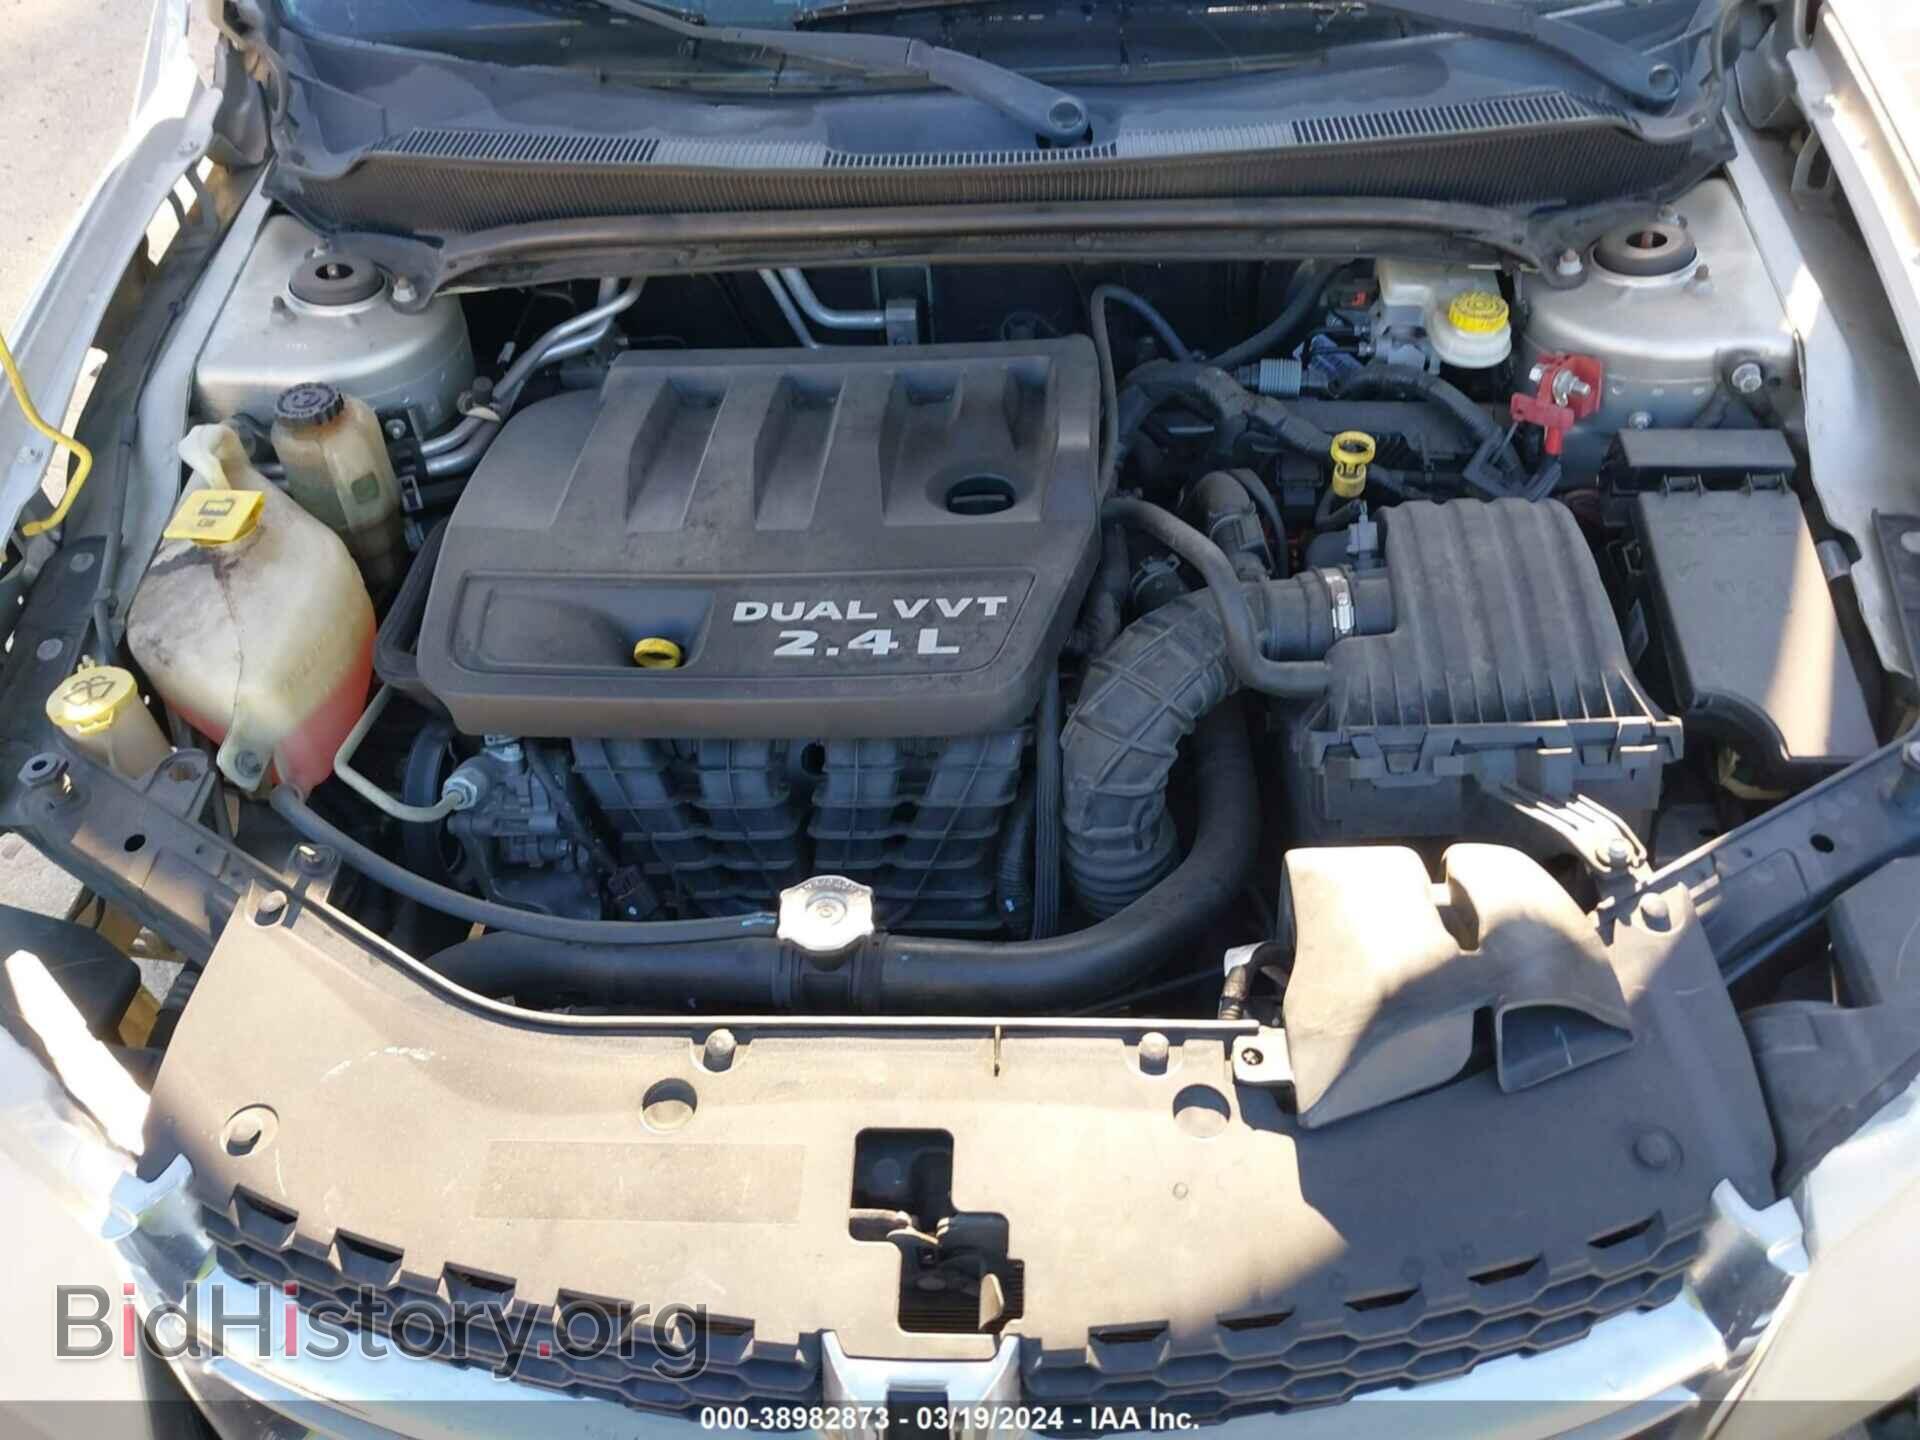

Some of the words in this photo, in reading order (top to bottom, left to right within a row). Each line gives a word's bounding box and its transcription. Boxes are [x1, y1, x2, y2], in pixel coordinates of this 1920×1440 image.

[732, 600, 877, 621] DUAL
[893, 596, 1008, 619] VVT
[774, 628, 899, 656] 2.4
[917, 628, 960, 654] L
